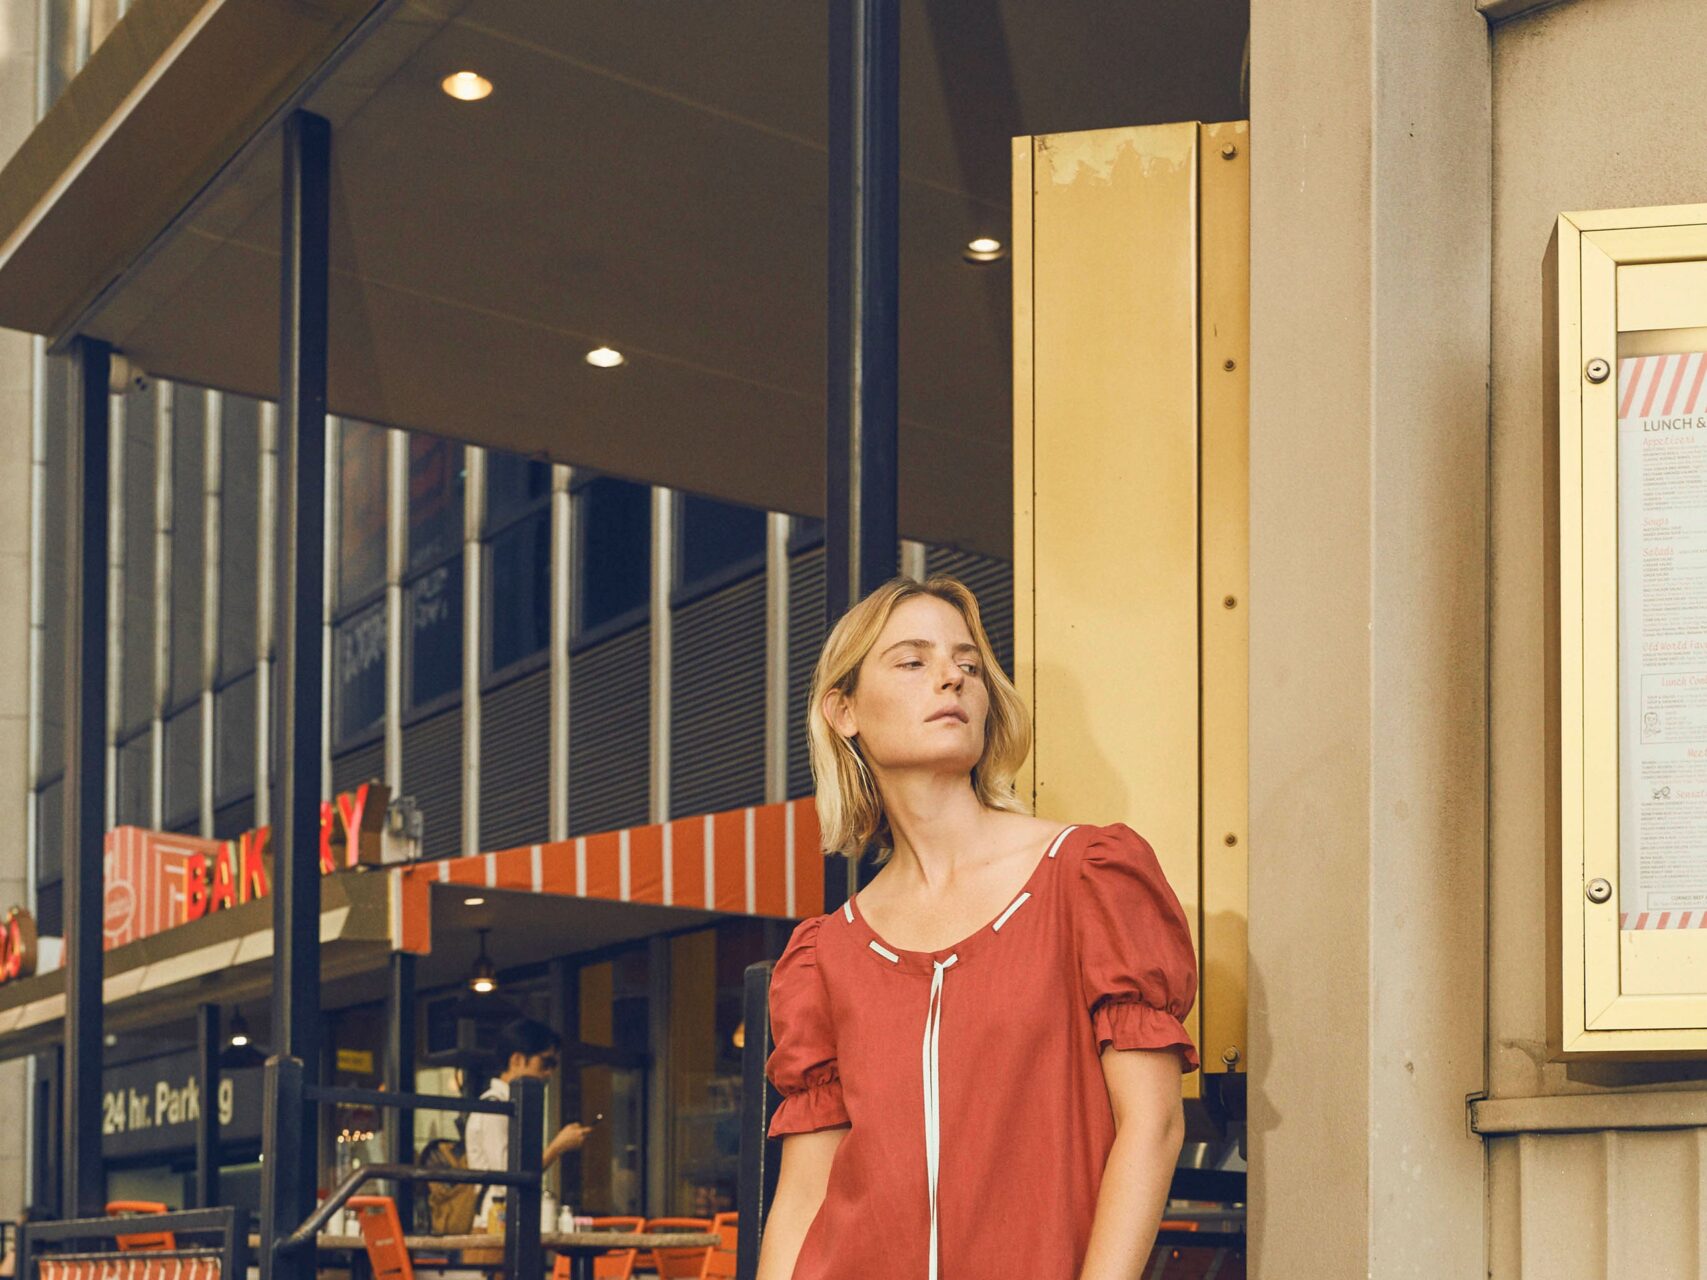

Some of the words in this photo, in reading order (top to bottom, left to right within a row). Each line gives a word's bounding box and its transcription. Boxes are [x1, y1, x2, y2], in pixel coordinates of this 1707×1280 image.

[1643, 418, 1692, 432] LUNCH
[1696, 417, 1707, 429] &
[181, 783, 370, 924] BAKRY
[102, 1089, 126, 1135] 24
[129, 1087, 151, 1130] hr.
[155, 1076, 234, 1125] Parkg
